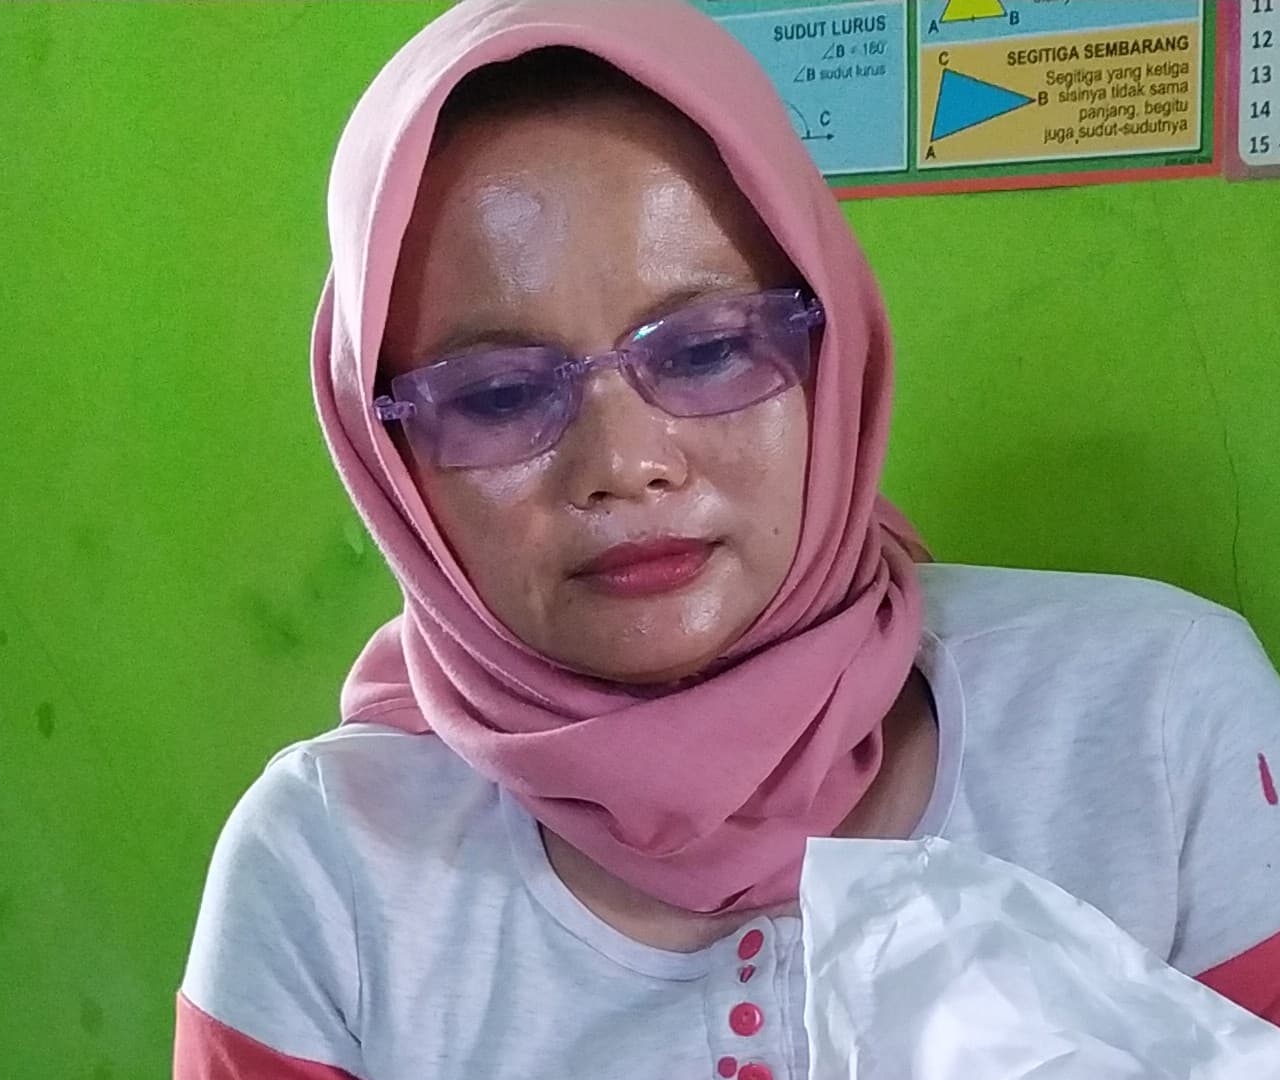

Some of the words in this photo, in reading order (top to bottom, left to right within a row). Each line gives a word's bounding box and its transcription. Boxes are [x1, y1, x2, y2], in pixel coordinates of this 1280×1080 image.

[773, 21, 827, 42] SUDUT
[831, 14, 887, 37] LURUS
[927, 19, 940, 35] A
[1009, 11, 1020, 26] B
[1251, 29, 1274, 51] 12
[938, 51, 949, 67] C
[1006, 45, 1080, 67] SEGITIGA
[1083, 35, 1190, 60] SEMBARANG
[1045, 69, 1103, 89] Segitiga
[1106, 66, 1142, 84] yang
[1145, 60, 1190, 79] ketiga
[1250, 64, 1272, 85] 13
[1037, 90, 1049, 106] B
[1058, 87, 1107, 105] sisinya
[1111, 81, 1146, 98] tidak
[1149, 80, 1189, 97] sama
[819, 109, 831, 127] C
[1144, 100, 1189, 118] begitu
[1249, 99, 1272, 120] 14
[1043, 126, 1074, 144] juga
[1077, 118, 1188, 140] sudut-sudutnya
[925, 145, 937, 161] A
[1248, 134, 1271, 155] 15
